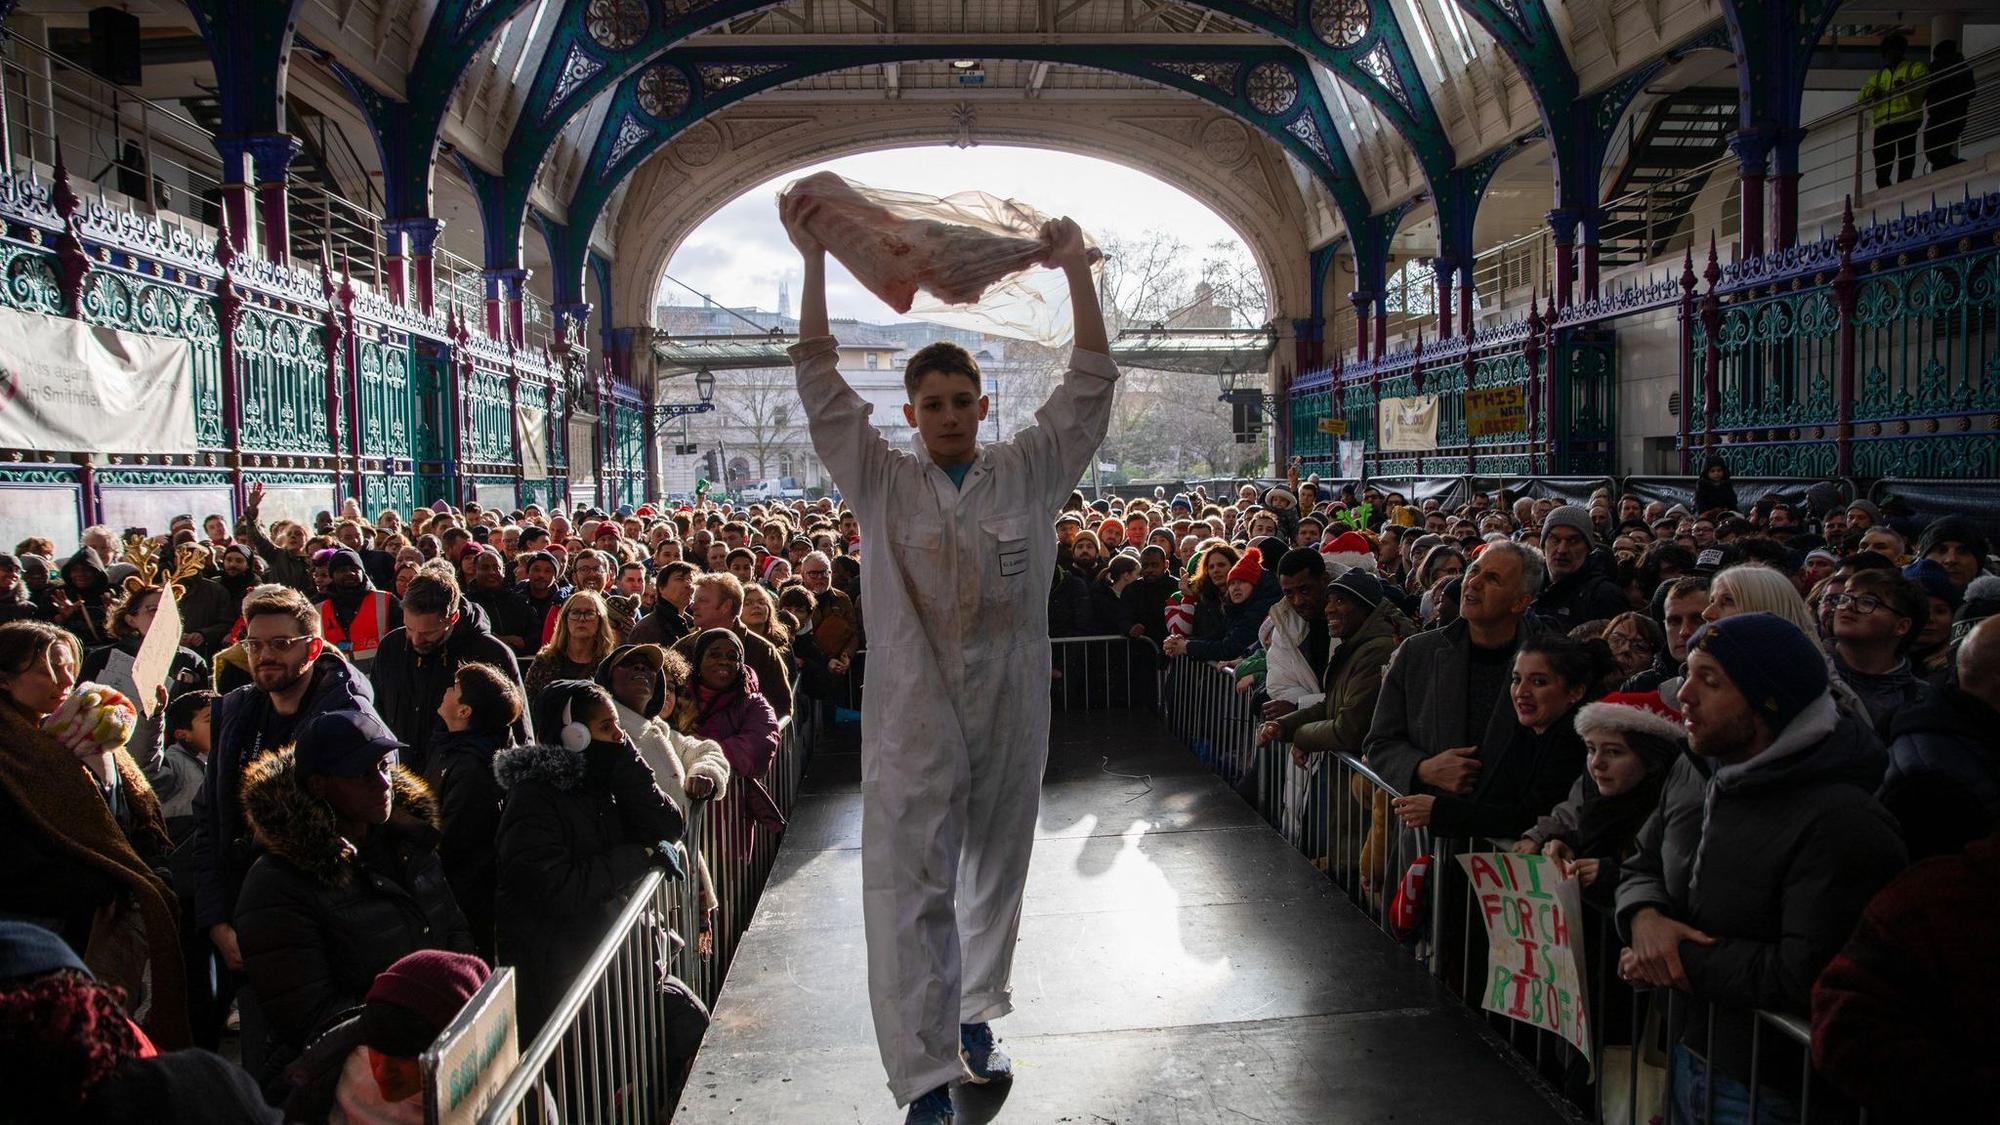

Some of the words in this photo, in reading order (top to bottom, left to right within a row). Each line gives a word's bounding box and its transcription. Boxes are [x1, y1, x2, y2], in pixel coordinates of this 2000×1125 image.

[43, 385, 102, 407] Smithfiel
[1466, 389, 1517, 409] THIS
[1479, 893, 1535, 939] FOR
[1538, 903, 1570, 947] CH
[1515, 938, 1556, 985] IS
[1490, 965, 1544, 1024] RIB
